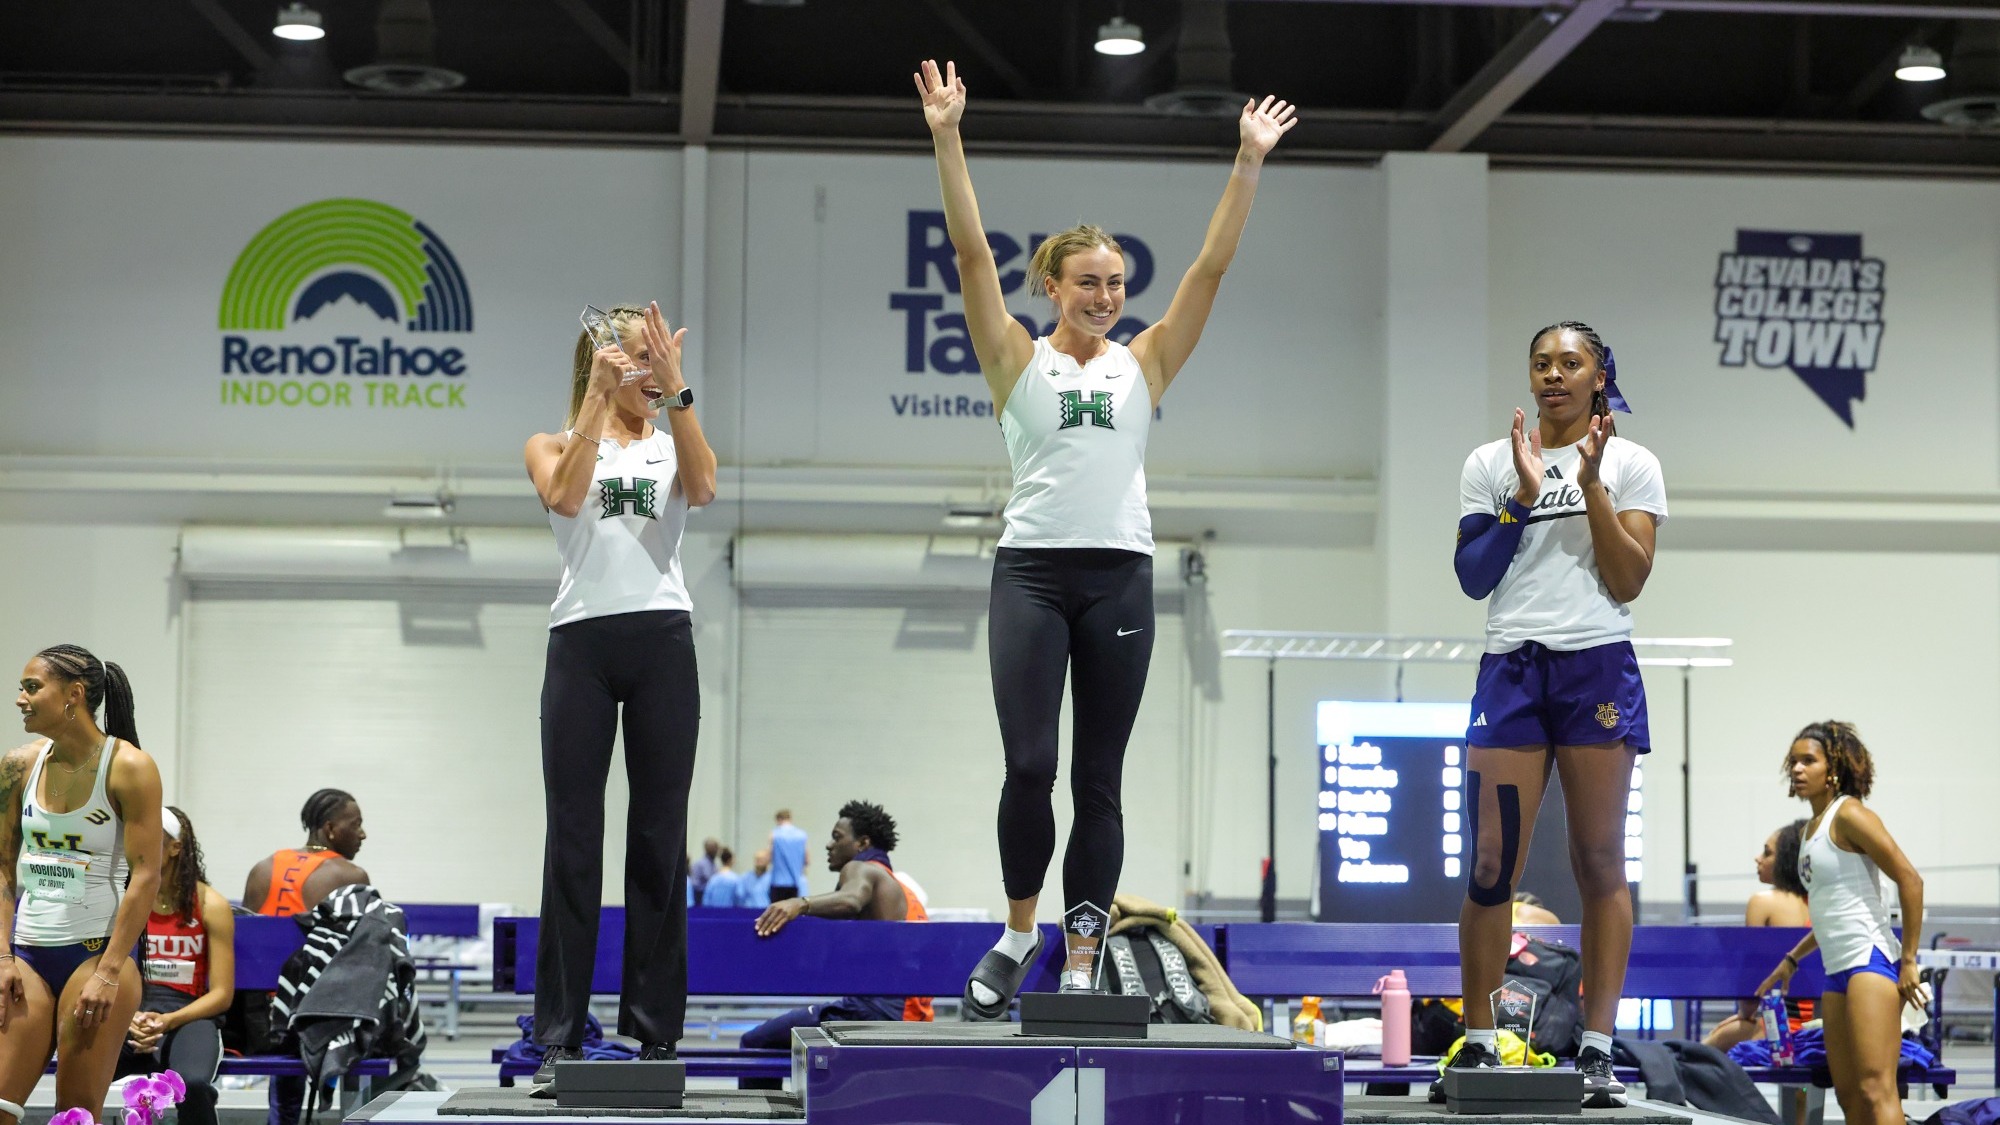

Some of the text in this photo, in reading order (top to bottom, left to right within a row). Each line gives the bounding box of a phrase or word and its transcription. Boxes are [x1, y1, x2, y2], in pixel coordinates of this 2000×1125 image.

[906, 210, 1155, 300] Reo
[1716, 254, 1884, 289] NEVADA'S
[1716, 287, 1883, 321] COLLEGE
[222, 334, 467, 377] RenoTahoe
[1716, 319, 1883, 369] TOWN
[220, 380, 467, 408] INDOOR TRACK
[1057, 390, 1117, 431] H
[598, 477, 658, 521] H
[29, 863, 75, 879] ROBINSON
[1071, 920, 1101, 929] MPSF
[145, 934, 204, 957] SUN
